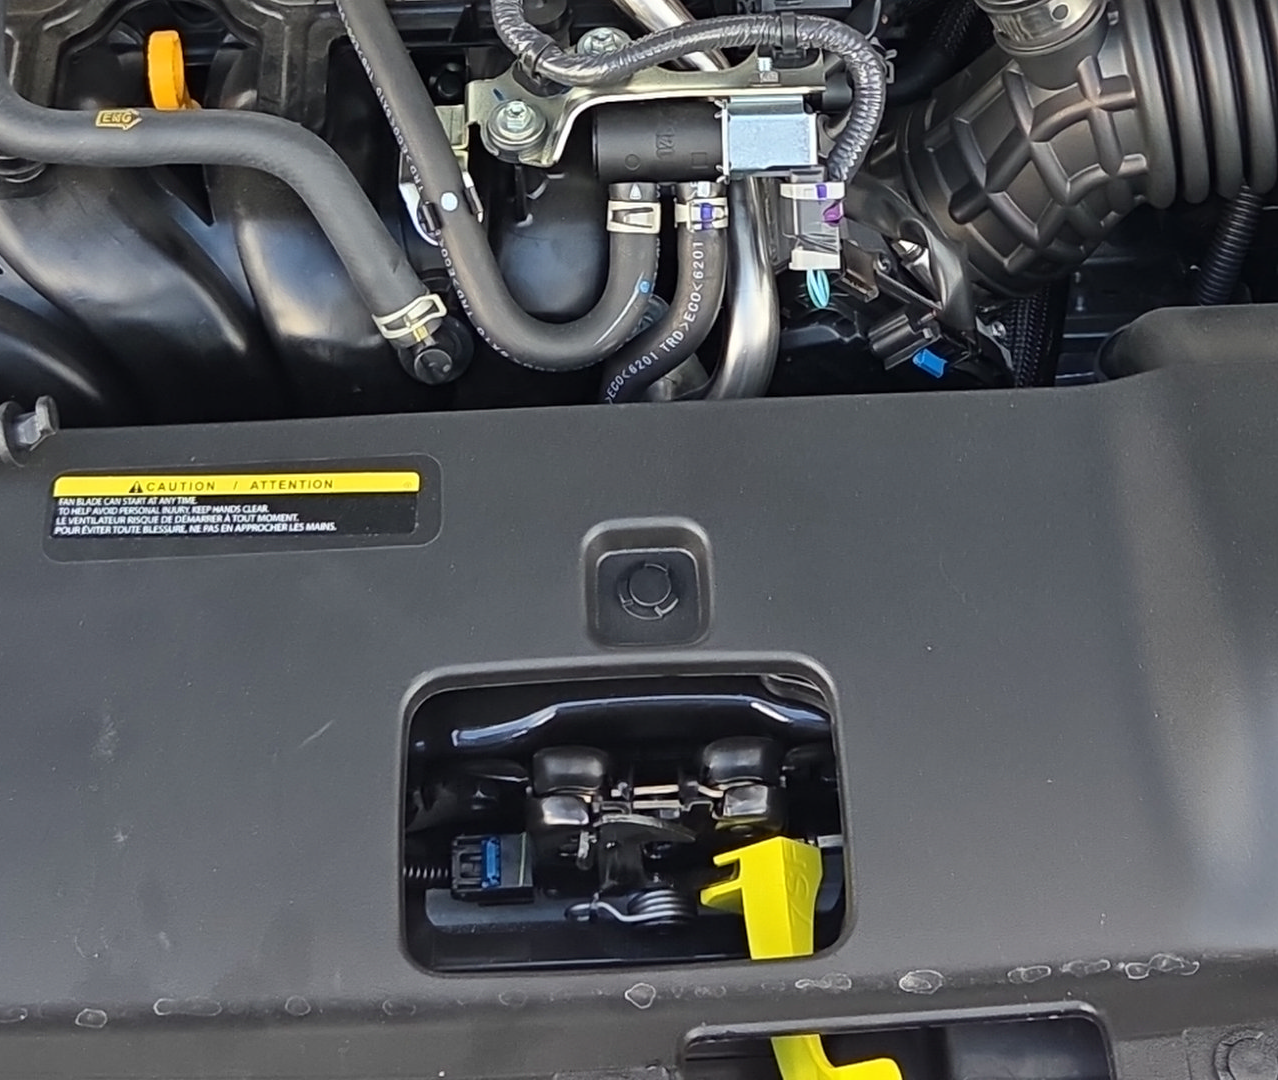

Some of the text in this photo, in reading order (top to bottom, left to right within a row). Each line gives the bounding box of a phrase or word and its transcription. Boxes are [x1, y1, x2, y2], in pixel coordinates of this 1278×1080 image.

[101, 111, 133, 124] ENG
[146, 481, 216, 492] CAUTION
[250, 479, 334, 490] ATTENTION
[58, 498, 75, 506] FAN
[76, 498, 102, 506] BLADE
[103, 498, 122, 506] CAN
[123, 497, 146, 505] START
[147, 497, 158, 505] AT
[158, 497, 176, 505] ANY
[58, 507, 70, 516] TO
[71, 507, 92, 516] HELP
[92, 507, 119, 516] AVOID
[120, 506, 160, 515] PERSONAL
[192, 506, 211, 514] KEEP
[212, 505, 241, 514] HANDS
[55, 517, 68, 525] LE
[68, 516, 126, 525] VENTILATEUR
[127, 516, 158, 525] RISQUE
[160, 515, 173, 523] DE
[175, 513, 223, 523] DÉMARRER
[233, 514, 256, 522] TOUT
[54, 526, 81, 535] POUR
[81, 524, 112, 534] ÉVITER
[112, 525, 141, 534] TOUTE
[189, 524, 202, 533] NE
[203, 524, 220, 533] PAS
[221, 524, 233, 532] EN
[234, 523, 288, 532] APPROCHER
[288, 522, 305, 531] LES
